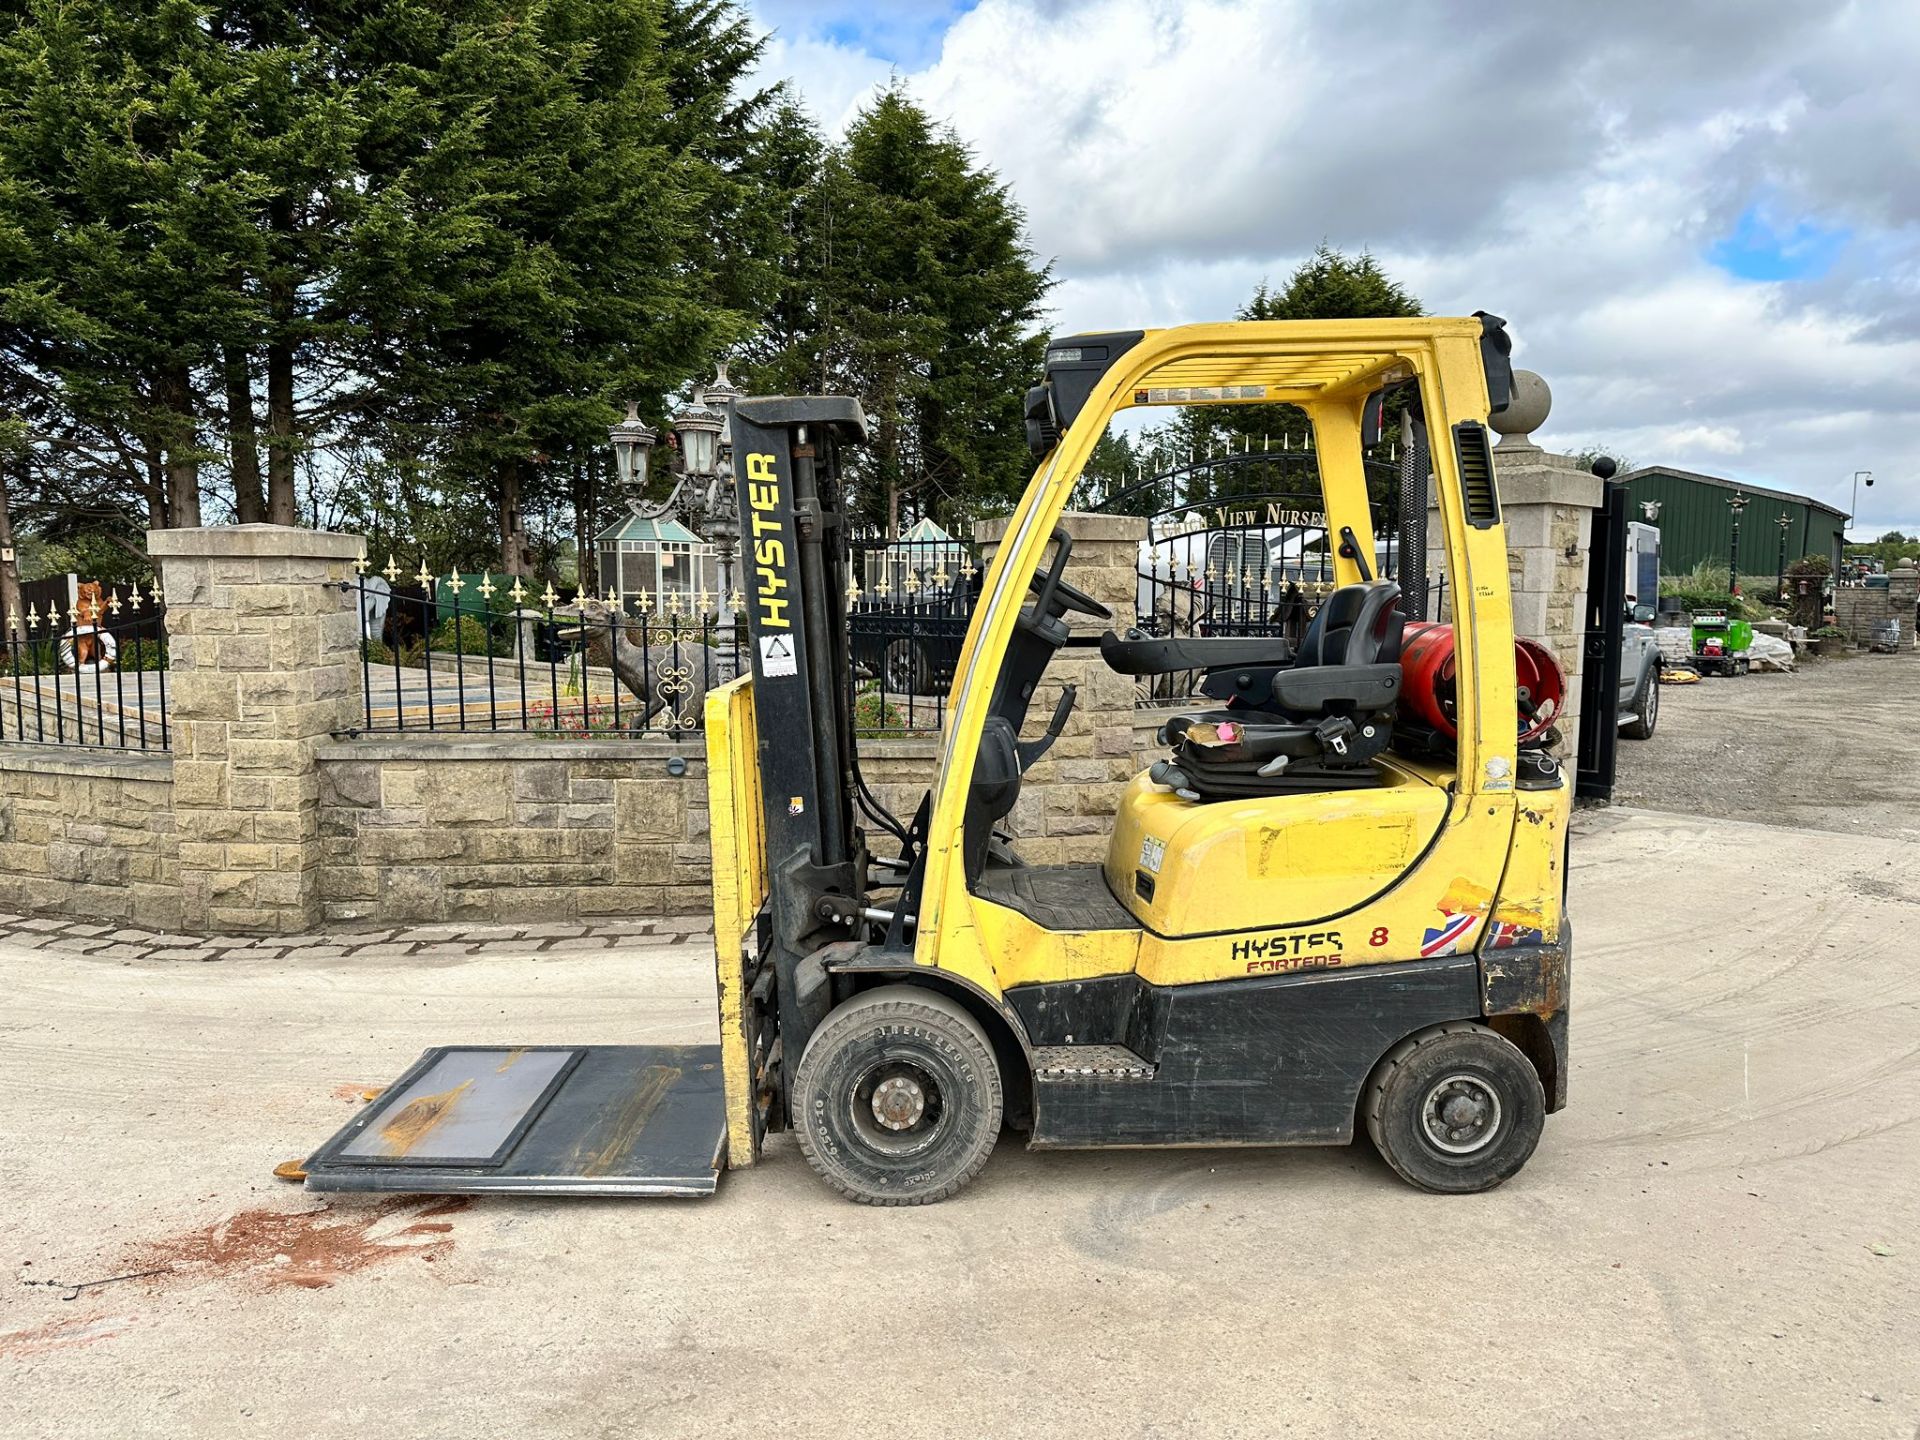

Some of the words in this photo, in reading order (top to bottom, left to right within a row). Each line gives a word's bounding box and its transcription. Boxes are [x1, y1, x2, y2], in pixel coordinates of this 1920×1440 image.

[746, 452, 791, 628] HYSTER
[1368, 926, 1389, 947] 8
[879, 1025, 975, 1083] TRELLEBORG
